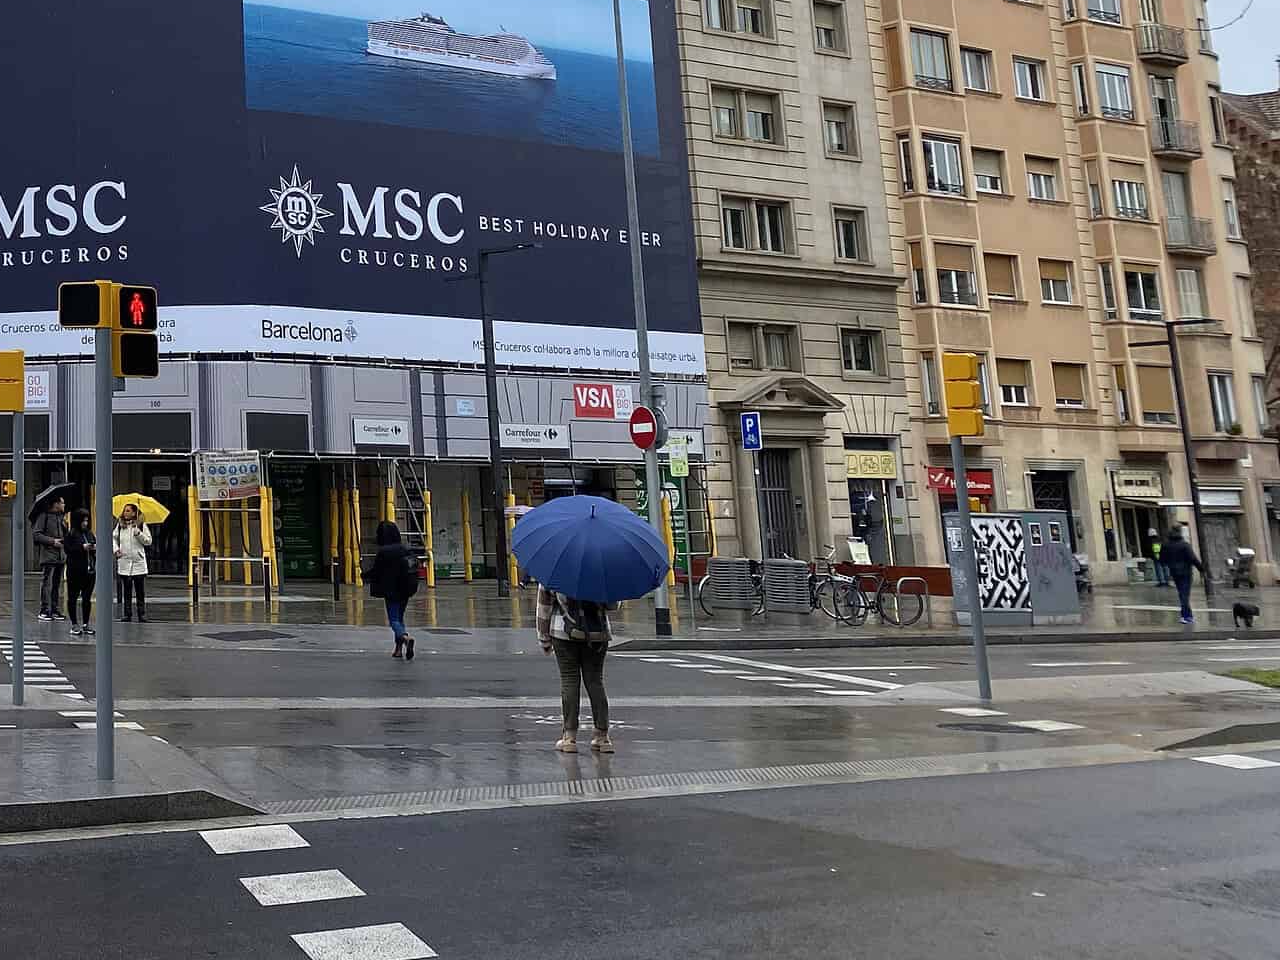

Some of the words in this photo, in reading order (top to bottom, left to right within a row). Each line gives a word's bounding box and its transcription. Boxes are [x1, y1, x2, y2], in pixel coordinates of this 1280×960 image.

[336, 182, 465, 245] MSC
[479, 216, 524, 234] BEST
[533, 221, 610, 242] HOLIDAY
[619, 230, 661, 247] EER
[340, 248, 468, 273] CRUCEROS
[1, 323, 46, 334] Cruceros
[261, 319, 343, 342] Barcelona
[472, 341, 484, 350] MS
[495, 340, 531, 352] Cruceros
[573, 345, 591, 356] amb
[28, 376, 41, 386] GO
[505, 428, 541, 438] Carrefour
[746, 418, 754, 432] P
